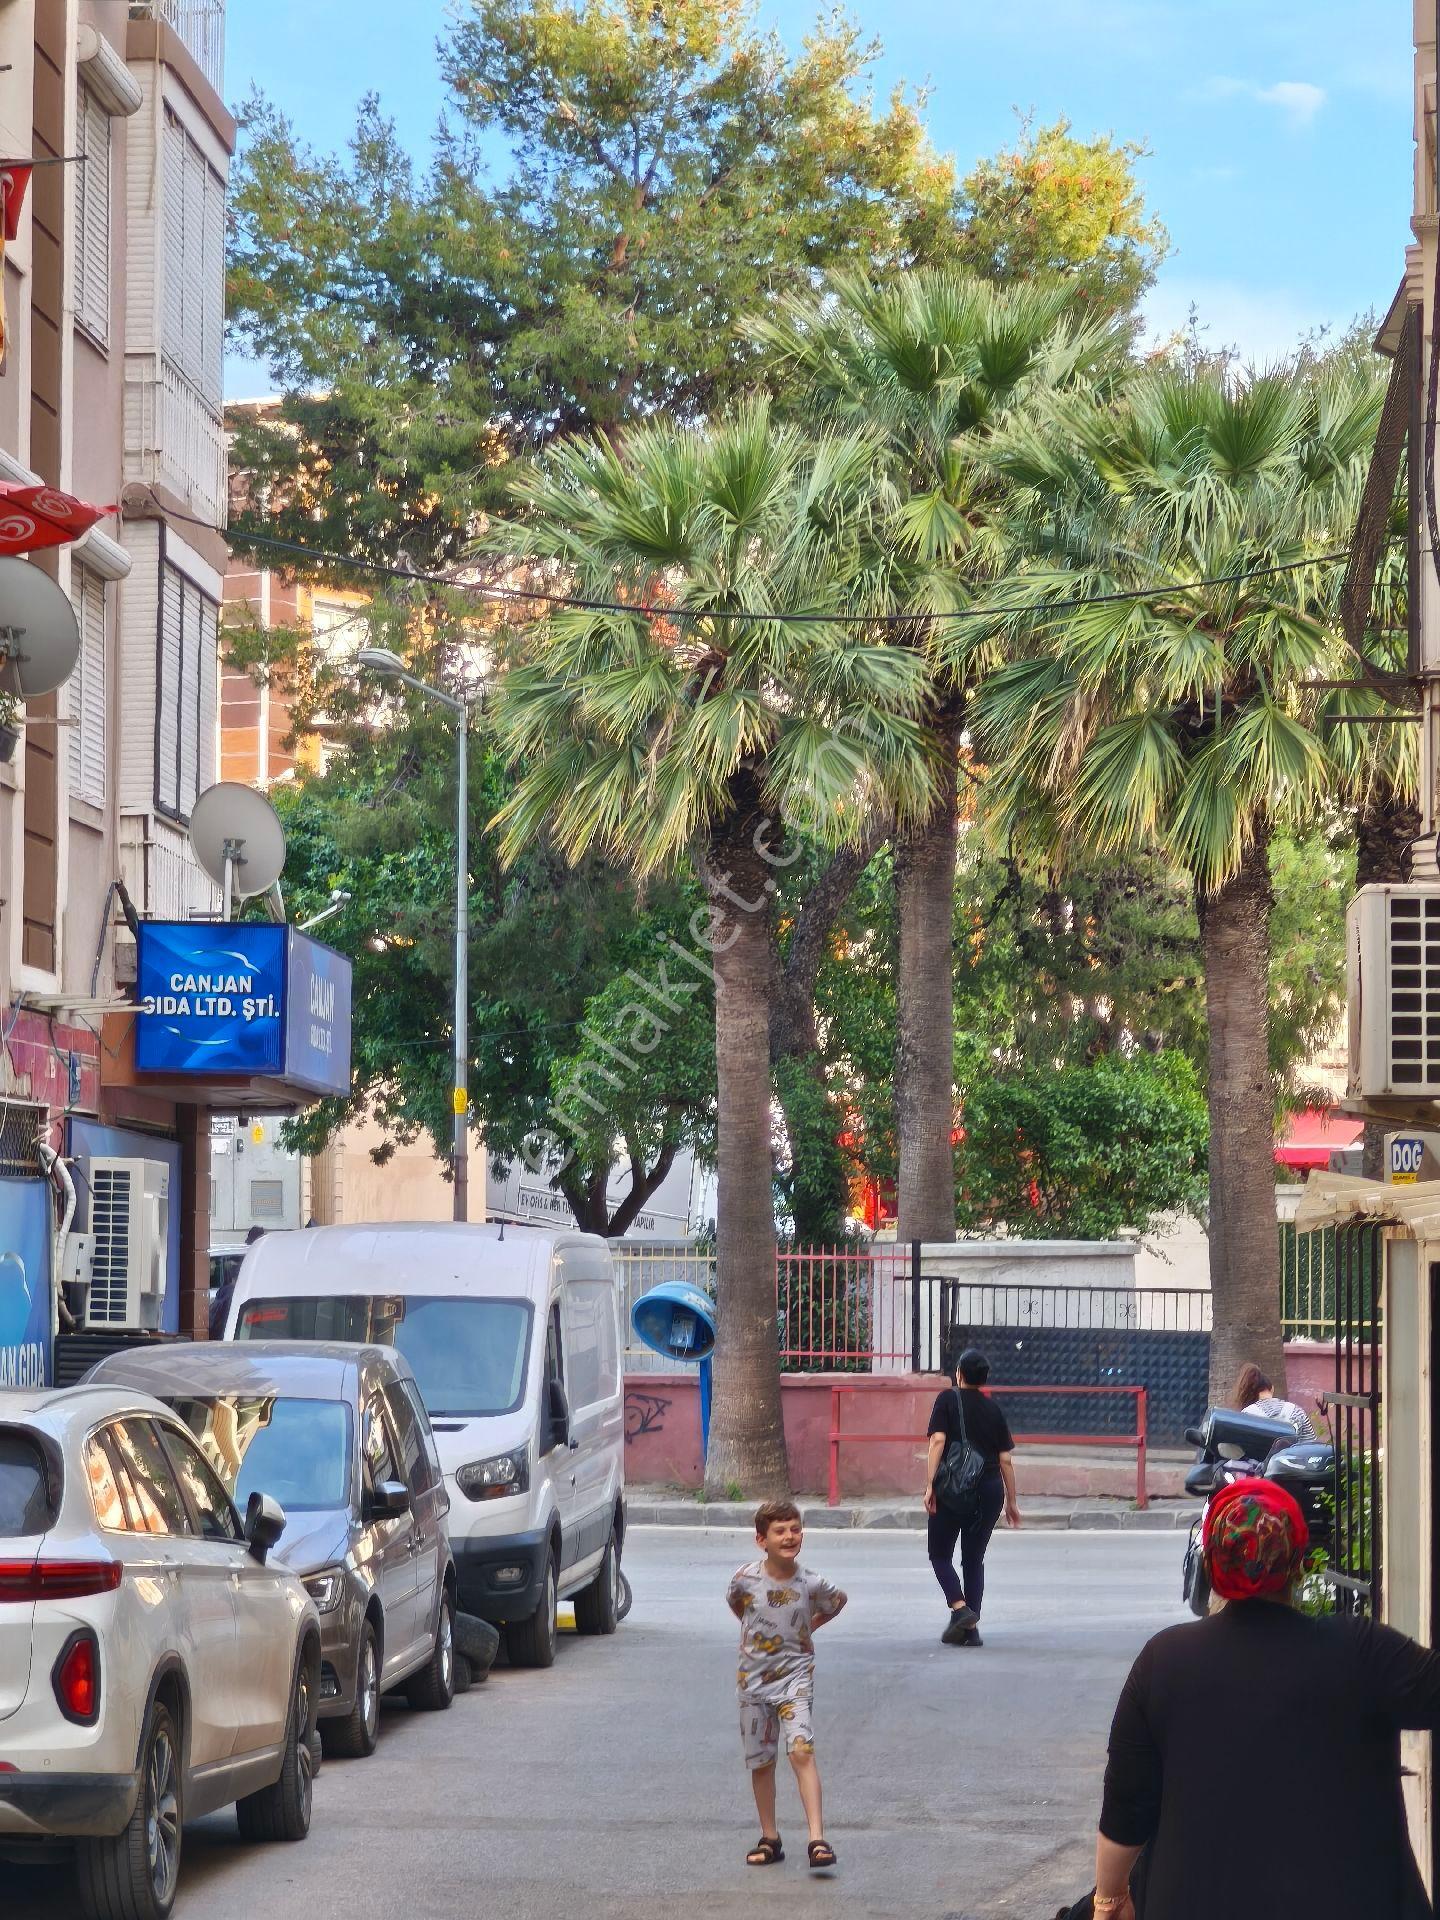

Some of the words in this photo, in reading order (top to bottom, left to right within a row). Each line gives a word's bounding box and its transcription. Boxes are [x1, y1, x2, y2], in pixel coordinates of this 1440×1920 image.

[170, 973, 252, 993] CANJAN
[143, 995, 191, 1016] GIDA
[195, 997, 237, 1017] LTD.
[242, 993, 280, 1021] ŞTİ.
[18, 1341, 45, 1388] GIDA
